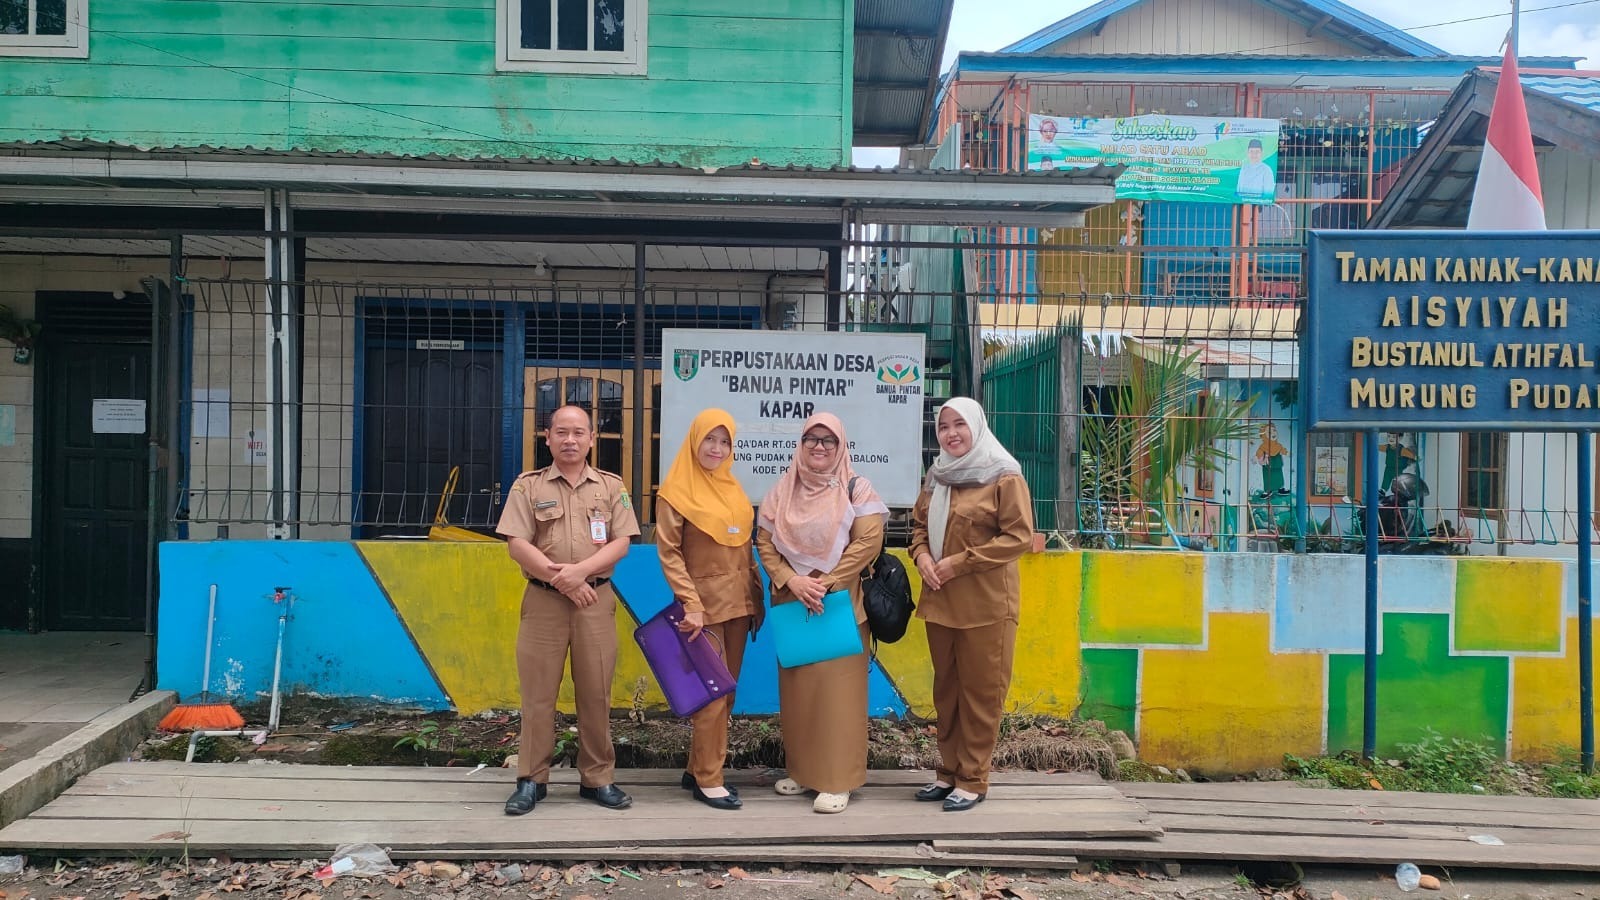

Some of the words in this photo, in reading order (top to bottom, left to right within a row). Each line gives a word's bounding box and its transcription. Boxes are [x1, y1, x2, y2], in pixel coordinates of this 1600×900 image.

[1111, 117, 1198, 142] Sukseskan
[1100, 144, 1137, 155] MILAD
[1142, 145, 1169, 155] SATU
[1172, 145, 1207, 156] ABAD
[1335, 251, 1426, 283] TAMAN
[1382, 296, 1568, 328] AISYIYAH
[700, 350, 828, 371] PERPUSTAKAAN
[834, 354, 875, 373] DESA
[1351, 336, 1484, 368] BUSTANUL
[1492, 343, 1594, 368] ATHFAL
[722, 375, 783, 394] "BANUA
[789, 377, 854, 396] PINTAR"
[876, 384, 896, 394] BANUA
[899, 385, 921, 395] PINTAR
[1351, 377, 1477, 408] MURUNG
[1509, 378, 1600, 409] PUDA
[888, 394, 908, 404] KAPAR
[759, 401, 815, 419] KAPAR
[772, 440, 797, 449] RT.05
[755, 453, 785, 462] PUDAK
[849, 454, 889, 463] ABALONG
[752, 465, 777, 474] KODE
